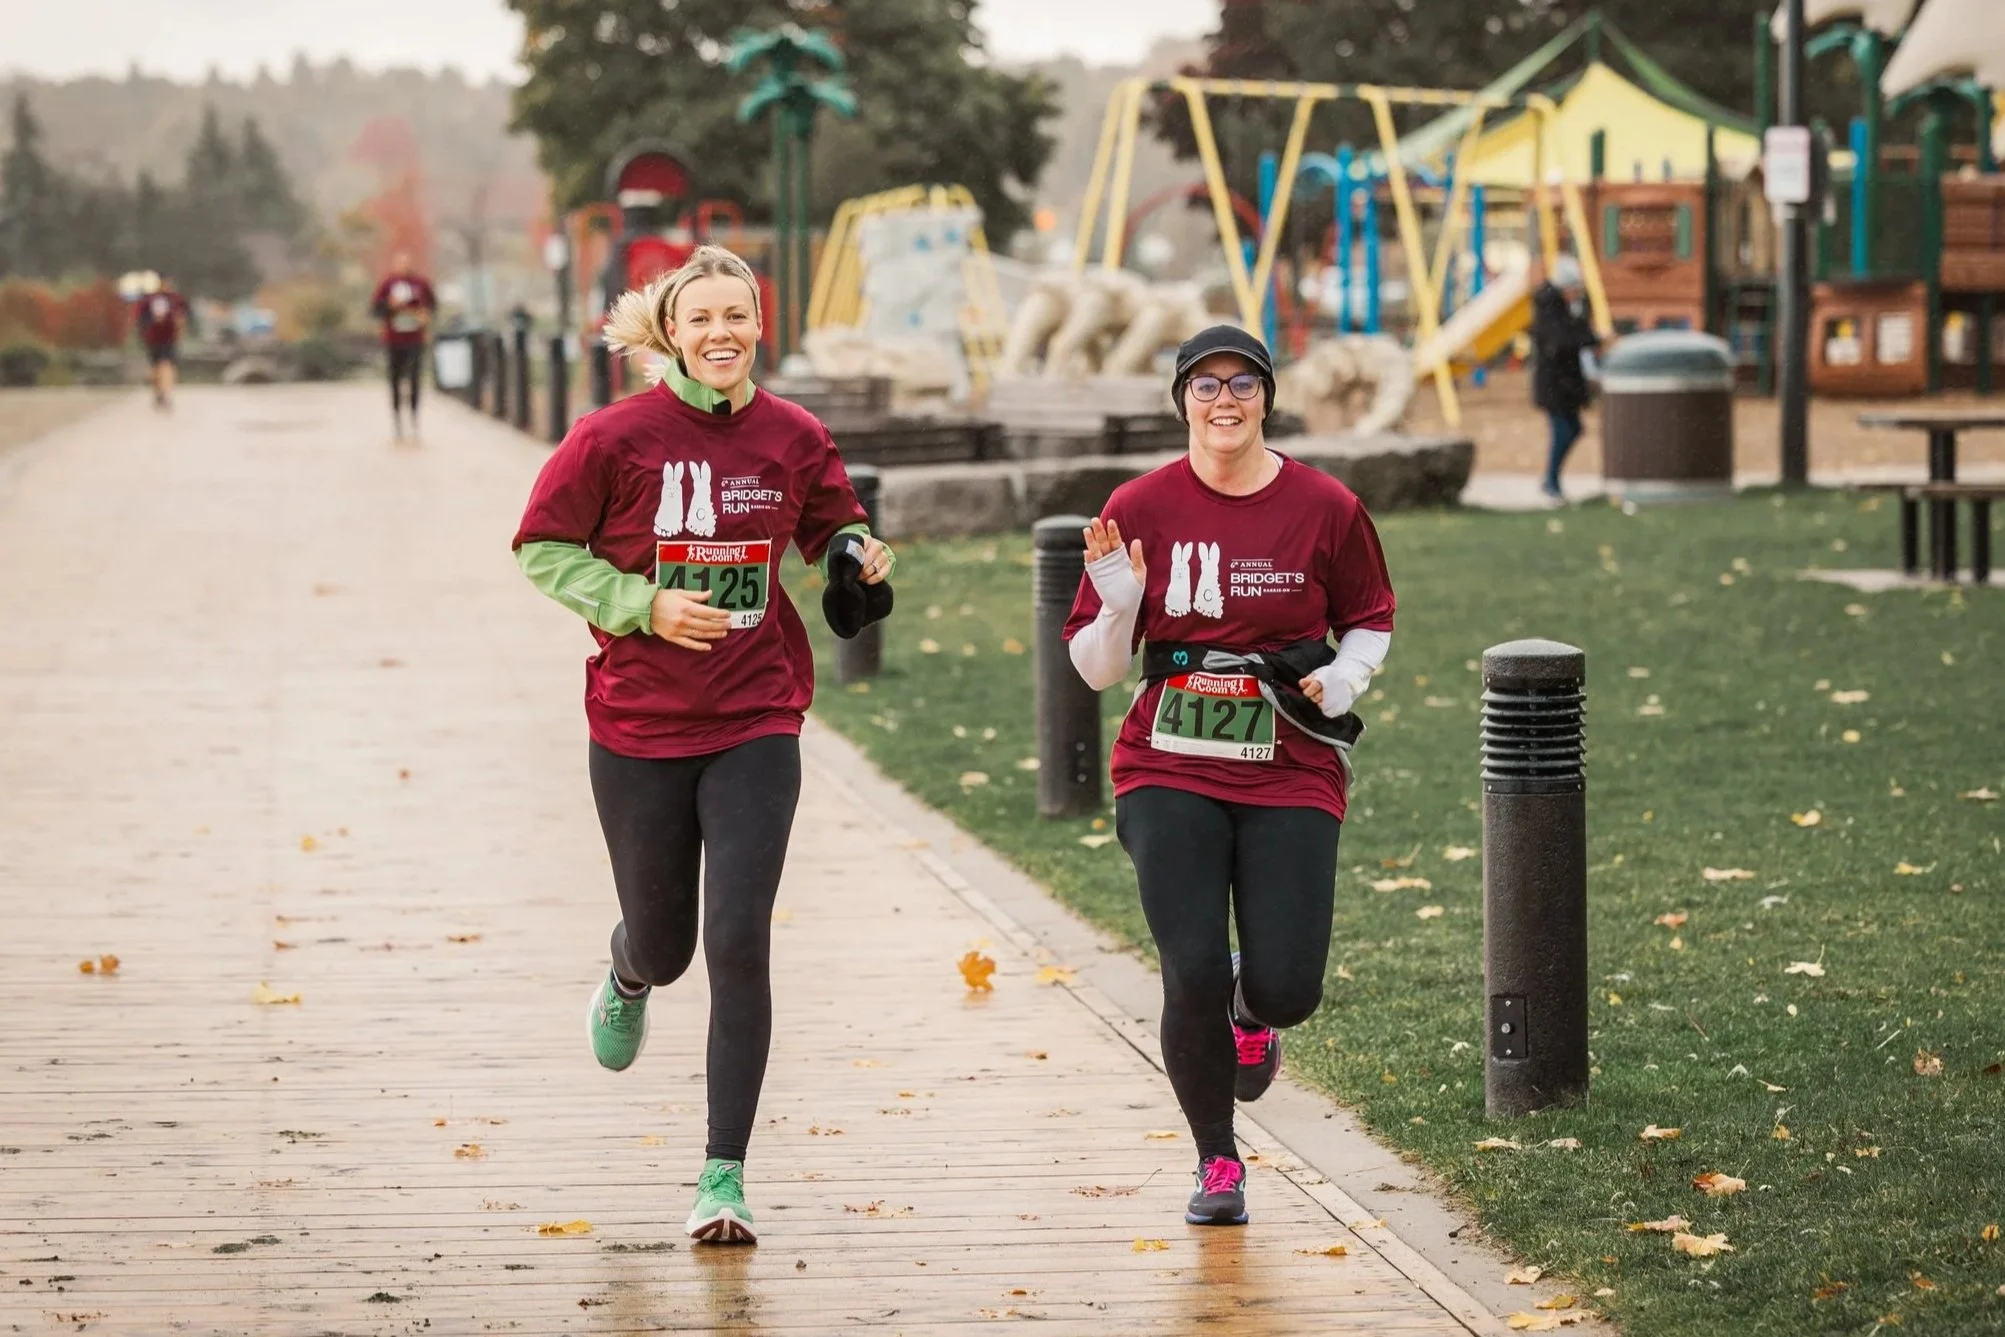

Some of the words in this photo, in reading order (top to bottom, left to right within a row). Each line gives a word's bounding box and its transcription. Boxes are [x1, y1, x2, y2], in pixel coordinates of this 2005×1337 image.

[721, 489, 783, 502] BRIDGET'S
[722, 502, 750, 515] RUN
[694, 545, 740, 562] Running
[1230, 572, 1305, 584] BRIDGET'S
[1230, 585, 1262, 597] RUN
[741, 613, 763, 626] 4125
[1192, 676, 1238, 694] Running
[1161, 692, 1264, 742] 4127
[1240, 747, 1271, 759] 4127
